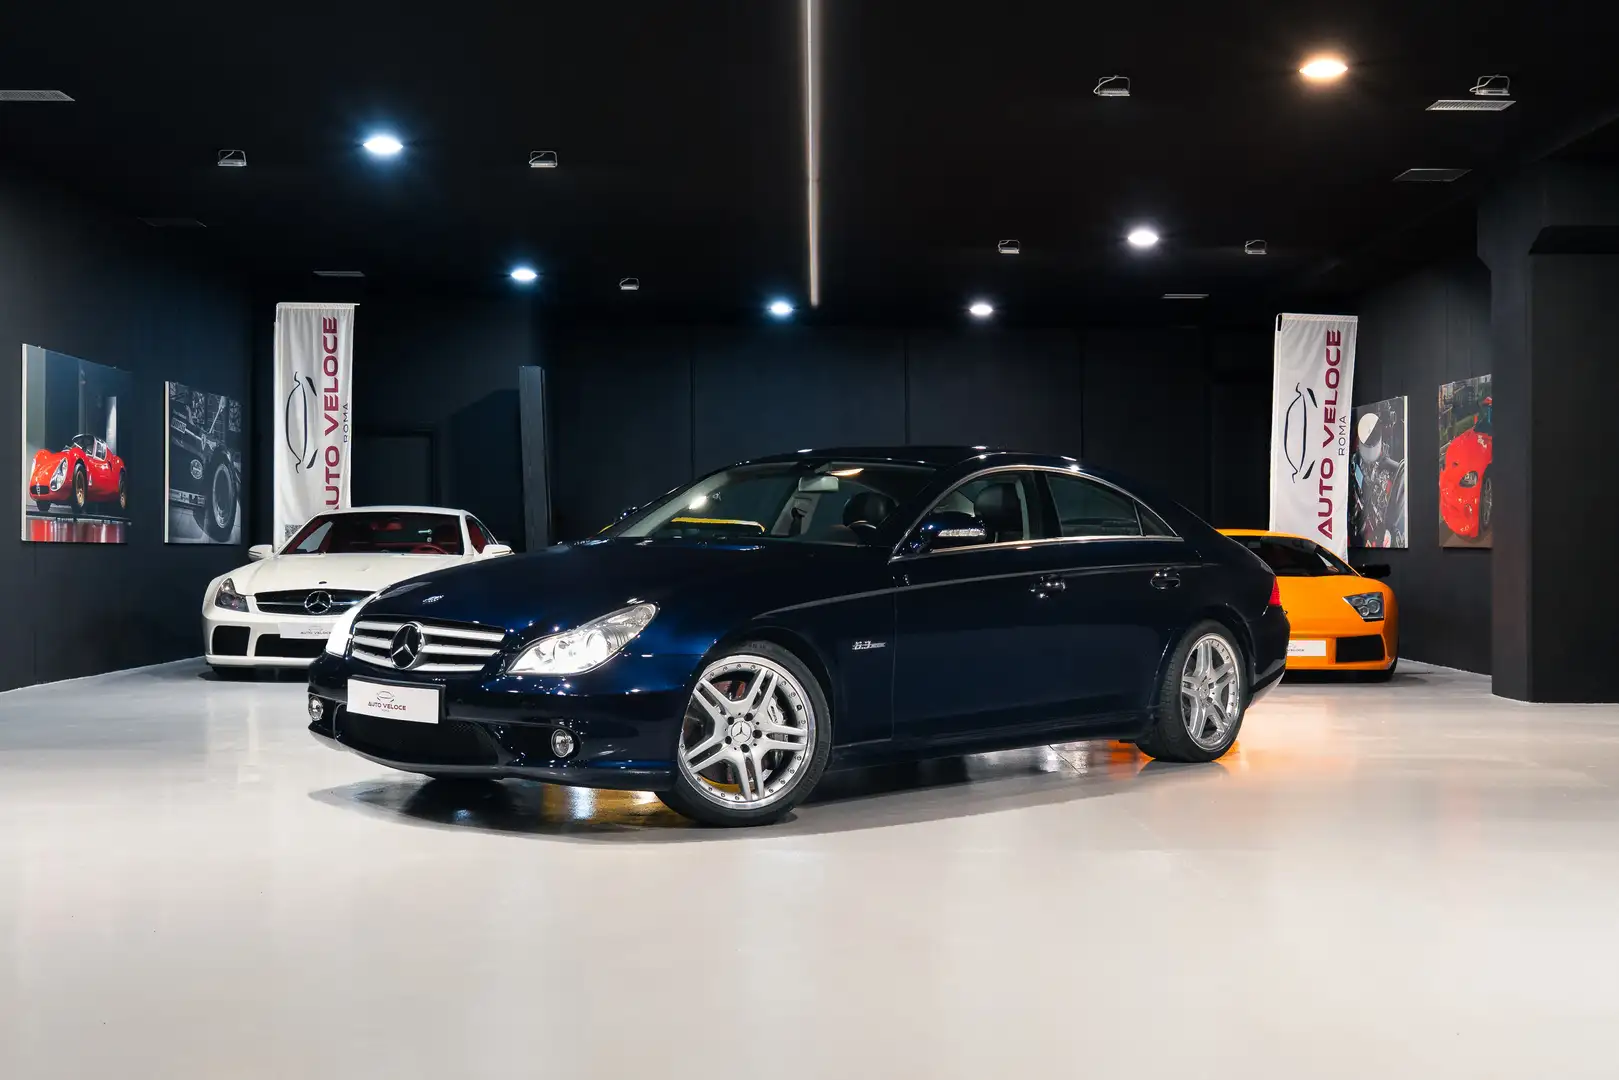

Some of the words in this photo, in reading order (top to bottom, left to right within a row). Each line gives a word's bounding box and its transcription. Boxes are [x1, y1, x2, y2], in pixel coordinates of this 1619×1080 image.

[322, 316, 339, 437] VELOCE
[1322, 329, 1341, 448] VELOCE
[1338, 415, 1346, 456] ROMA
[324, 445, 340, 510] UTO
[1317, 457, 1334, 540] AUTO
[382, 702, 407, 711] VELOCE
